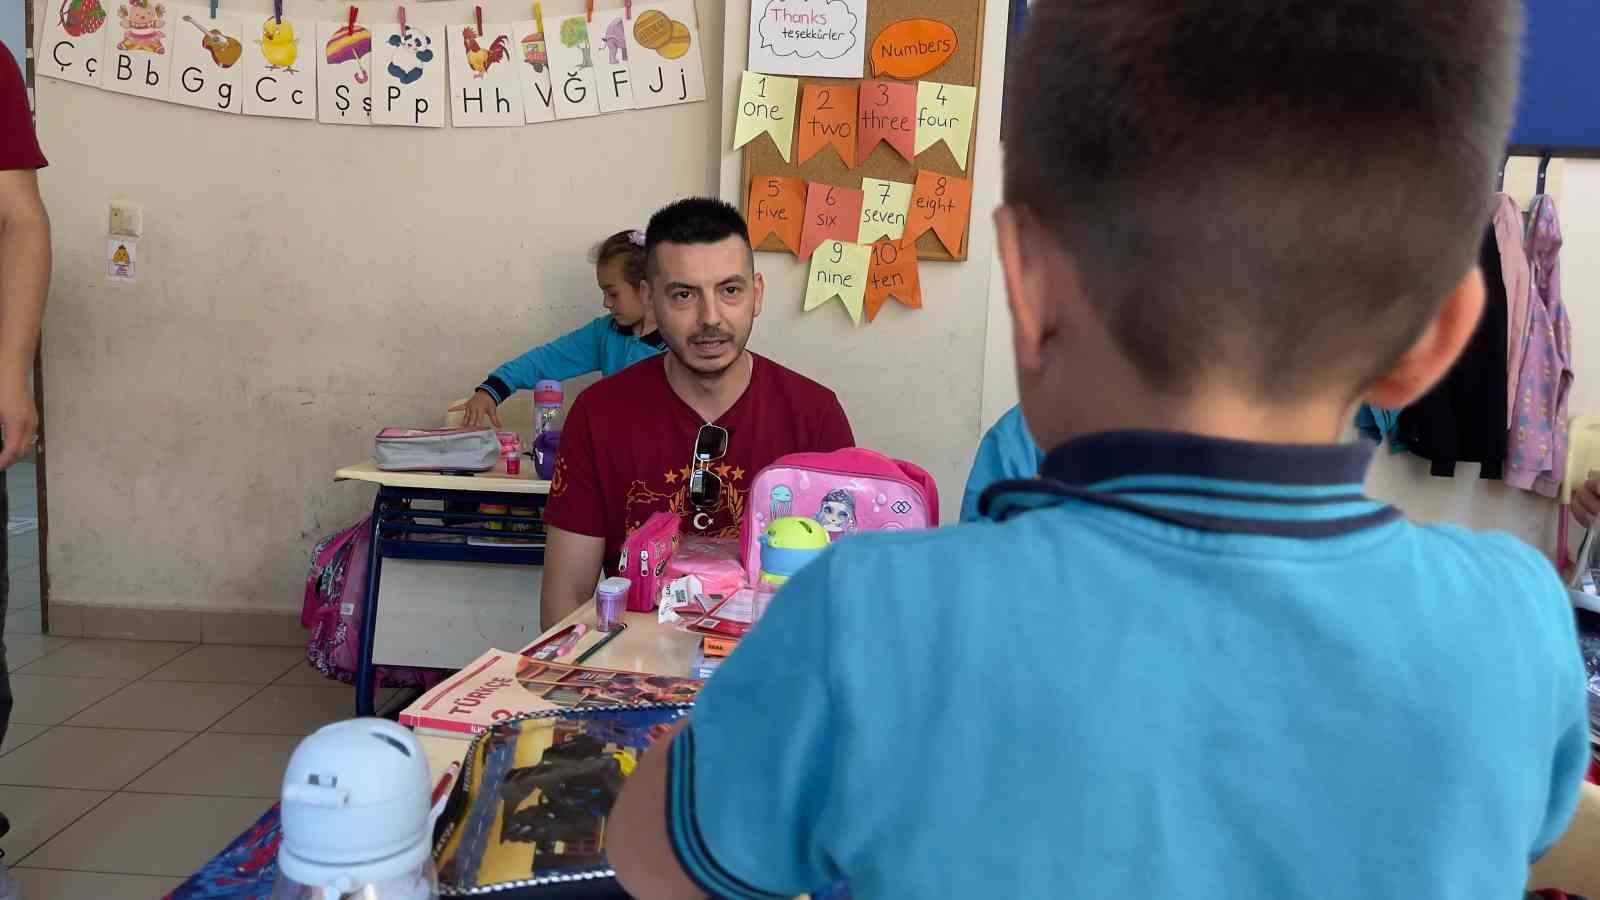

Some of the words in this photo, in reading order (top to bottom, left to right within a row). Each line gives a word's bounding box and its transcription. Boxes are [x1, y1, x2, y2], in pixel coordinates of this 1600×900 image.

[770, 7, 828, 26] Thanks
[53, 41, 74, 72] Ç
[85, 57, 97, 77] ç
[880, 38, 951, 59] Numbers
[116, 54, 133, 81] B
[145, 59, 160, 86] b
[181, 66, 205, 93] G
[217, 83, 232, 109] g
[255, 76, 277, 102] C
[291, 89, 303, 105] c
[563, 71, 587, 104] Ğ
[612, 69, 628, 98] F
[648, 66, 664, 93] J
[678, 68, 688, 100] j
[758, 77, 766, 98] 1
[335, 84, 350, 117] Ş
[362, 96, 372, 117] ş
[387, 85, 401, 112] P
[415, 98, 429, 124] p
[463, 87, 483, 113] H
[495, 87, 510, 113] h
[534, 82, 552, 108] V
[816, 89, 834, 111] 2
[874, 83, 889, 107] 3
[936, 85, 948, 106] 4
[743, 101, 784, 121] one
[861, 109, 912, 132] three
[917, 107, 960, 129] four
[807, 115, 851, 139] two
[767, 180, 781, 197] 5
[825, 186, 836, 206] 6
[878, 184, 891, 205] 7
[934, 176, 947, 196] 8
[755, 200, 789, 221] five
[815, 213, 838, 227] six
[863, 207, 906, 226] seven
[916, 197, 955, 220] eight
[830, 241, 844, 264] 9
[872, 242, 898, 266] 10
[816, 269, 853, 288] nine
[871, 270, 905, 289] ten
[448, 677, 513, 715] TÜRKÇE
